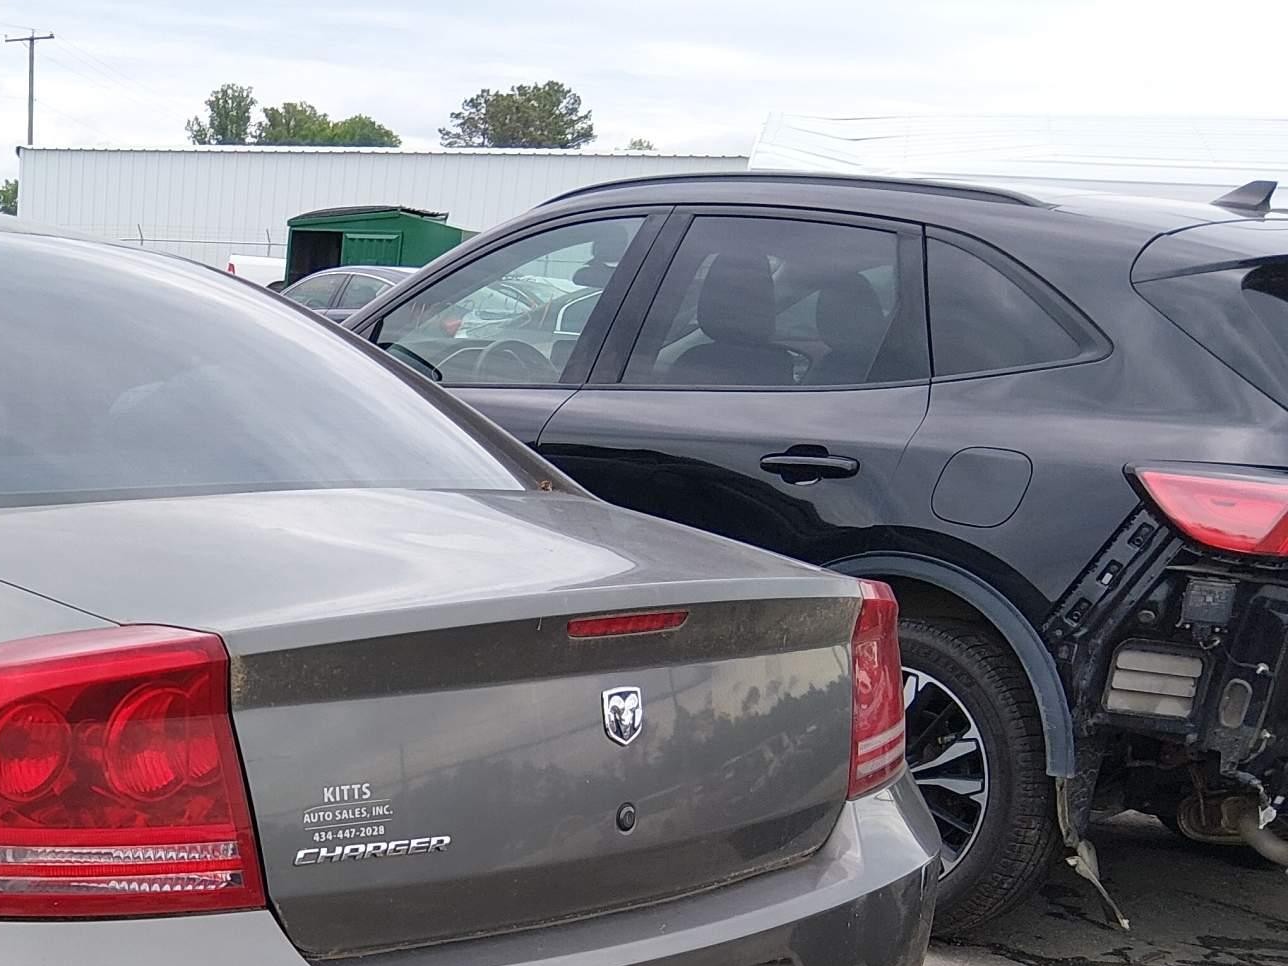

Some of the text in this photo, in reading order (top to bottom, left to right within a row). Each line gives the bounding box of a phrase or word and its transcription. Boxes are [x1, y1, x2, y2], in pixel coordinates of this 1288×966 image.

[323, 783, 371, 803] KITTS
[303, 804, 394, 824] AUTO SALES, INC.
[313, 826, 385, 842] 434-447-2028
[294, 836, 451, 866] CHARGER
